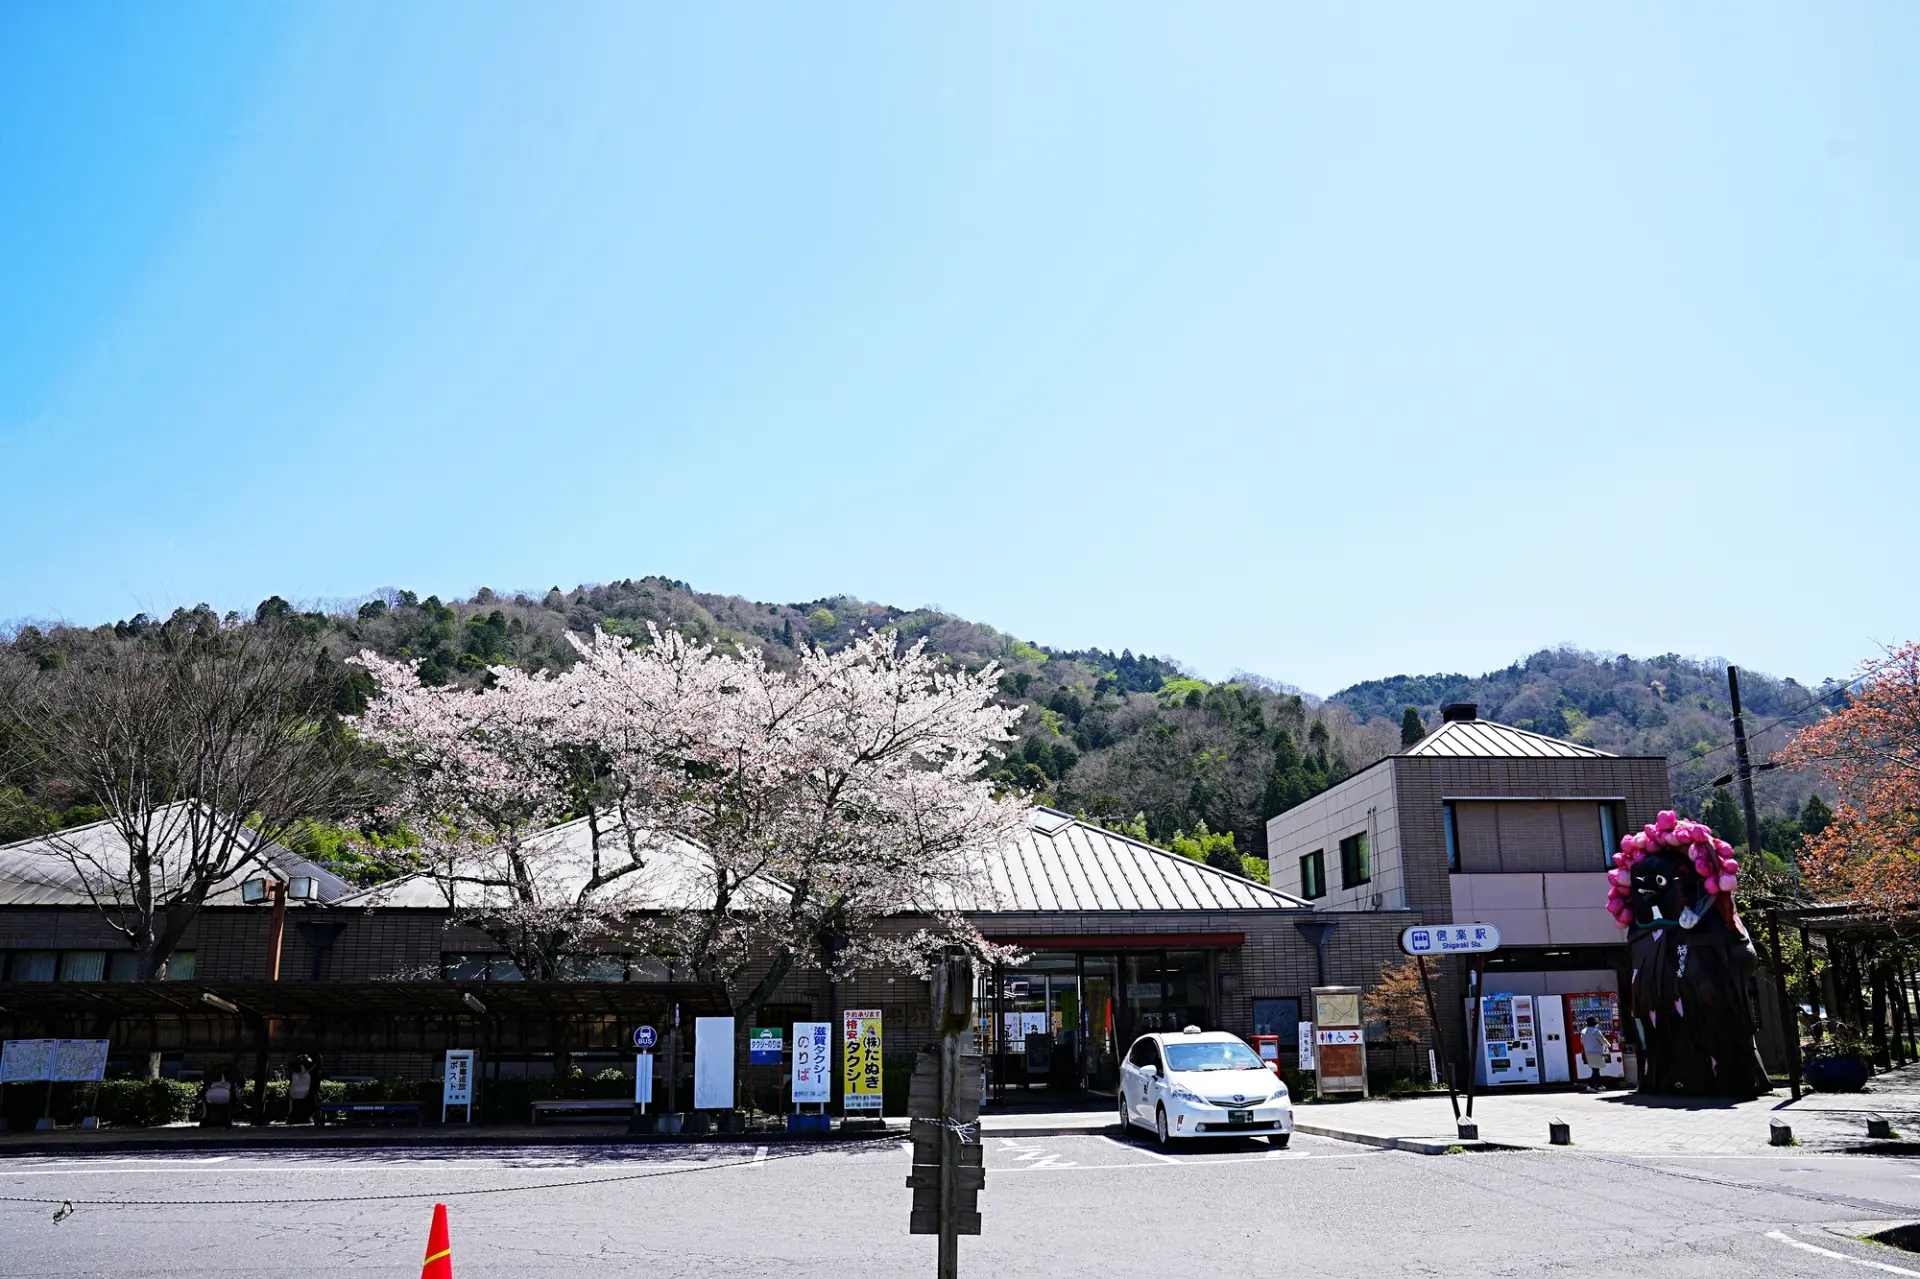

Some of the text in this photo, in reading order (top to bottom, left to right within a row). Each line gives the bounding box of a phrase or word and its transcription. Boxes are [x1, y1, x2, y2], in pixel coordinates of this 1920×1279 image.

[1436, 928, 1487, 941] 信楽駅
[1442, 941, 1469, 949] Shigaraki
[751, 1040, 781, 1049] タクシーのりば
[813, 1026, 826, 1083] 滋賀タクシー
[797, 1036, 810, 1081] のりば
[449, 1060, 458, 1091] ポスト
